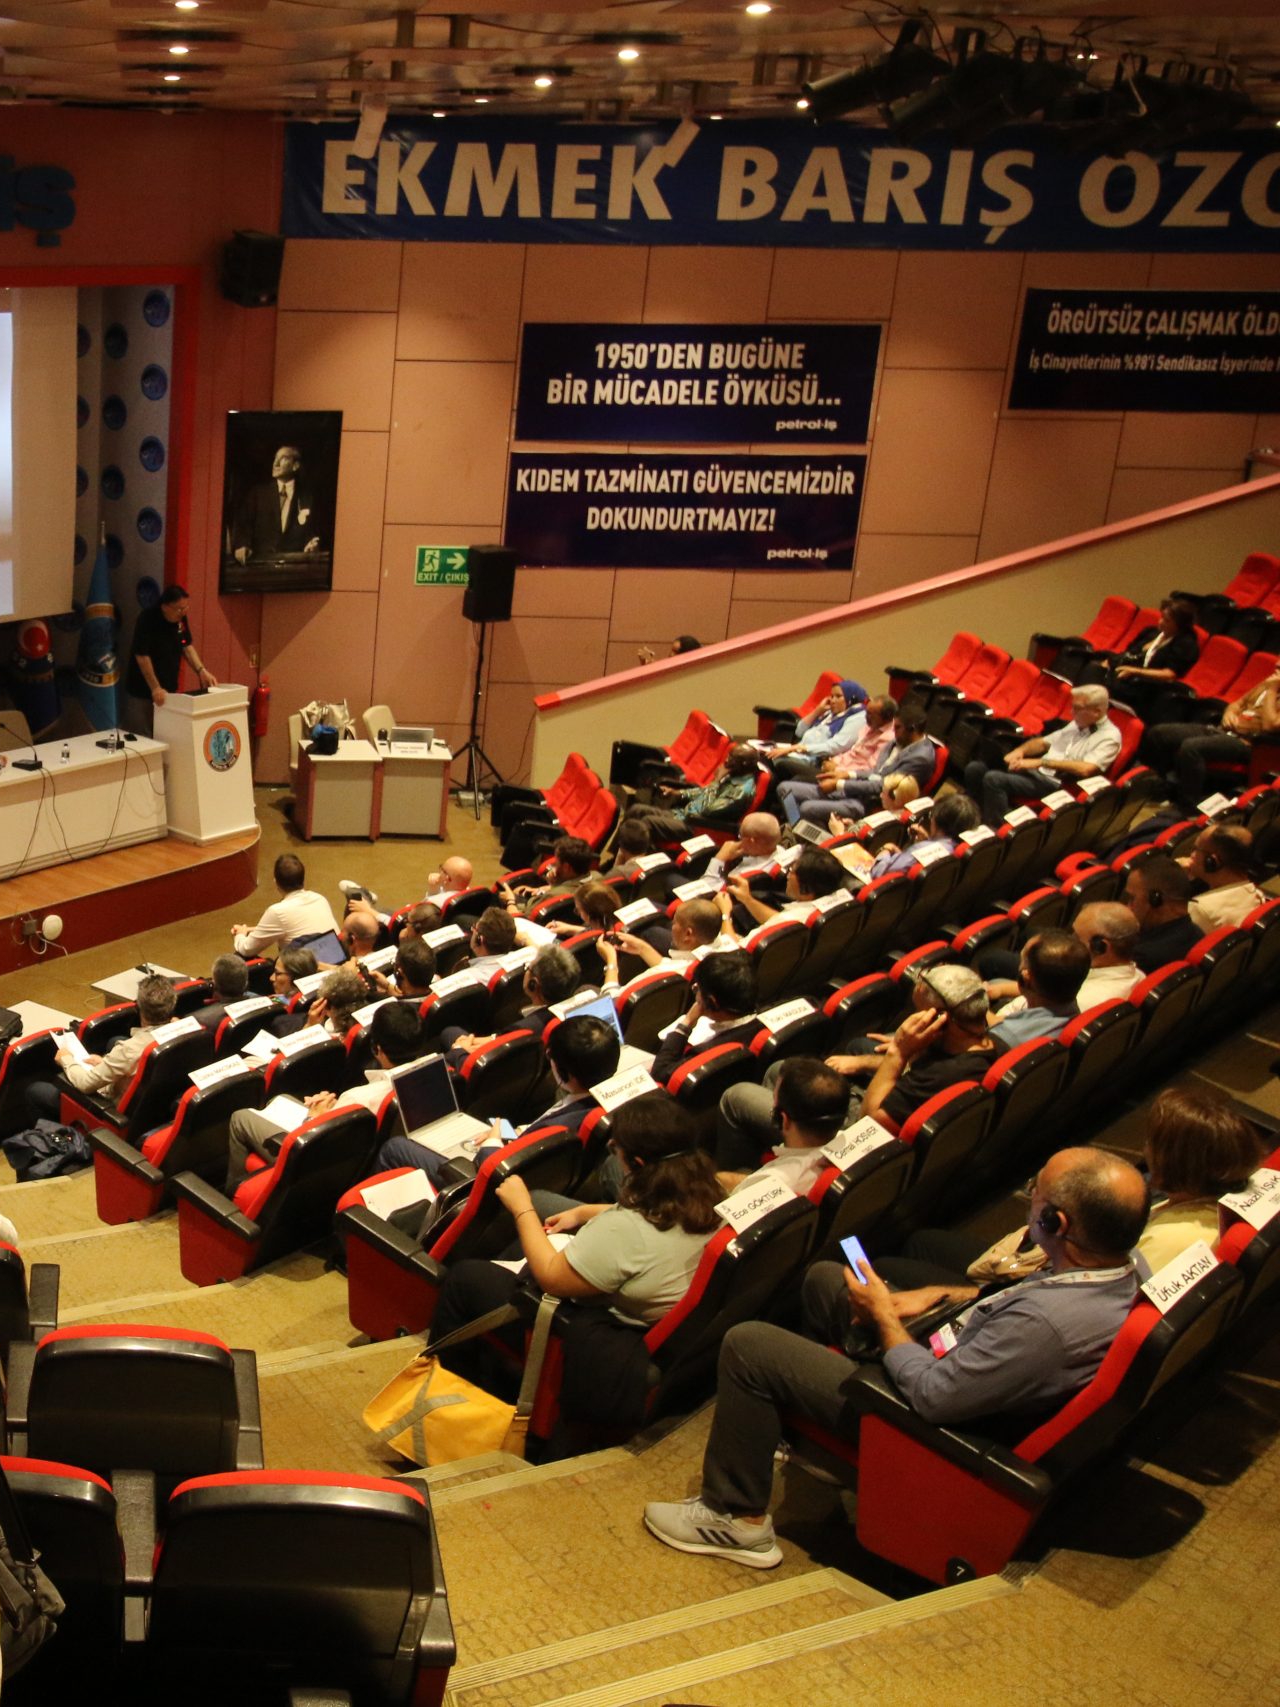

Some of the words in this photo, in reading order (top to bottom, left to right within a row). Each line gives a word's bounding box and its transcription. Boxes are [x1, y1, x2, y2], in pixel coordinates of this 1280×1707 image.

[322, 140, 672, 220] EKMEK
[715, 144, 1034, 244] BARIŞ
[1047, 303, 1142, 334] ÖRGÜTSÜZ
[1146, 311, 1239, 341] ÇALIŞMAK
[1242, 305, 1280, 336] ÖLD
[708, 337, 805, 370] BUGÜNE
[1156, 355, 1217, 372] Sendikasız
[547, 374, 588, 405] BİR
[593, 374, 718, 406] MÜCADELE
[723, 374, 841, 406] ÖYKÜSÜ...
[516, 469, 578, 492] KIDEM
[585, 463, 687, 493] TAZMİNATI
[693, 464, 855, 495] GÜVENCEMİZDİR
[587, 507, 776, 532] DOKUNDURTMAYIZ!
[418, 573, 438, 582] EXIT
[1157, 1280, 1185, 1303] Ufuk
[1181, 1255, 1213, 1285] AKTAN
